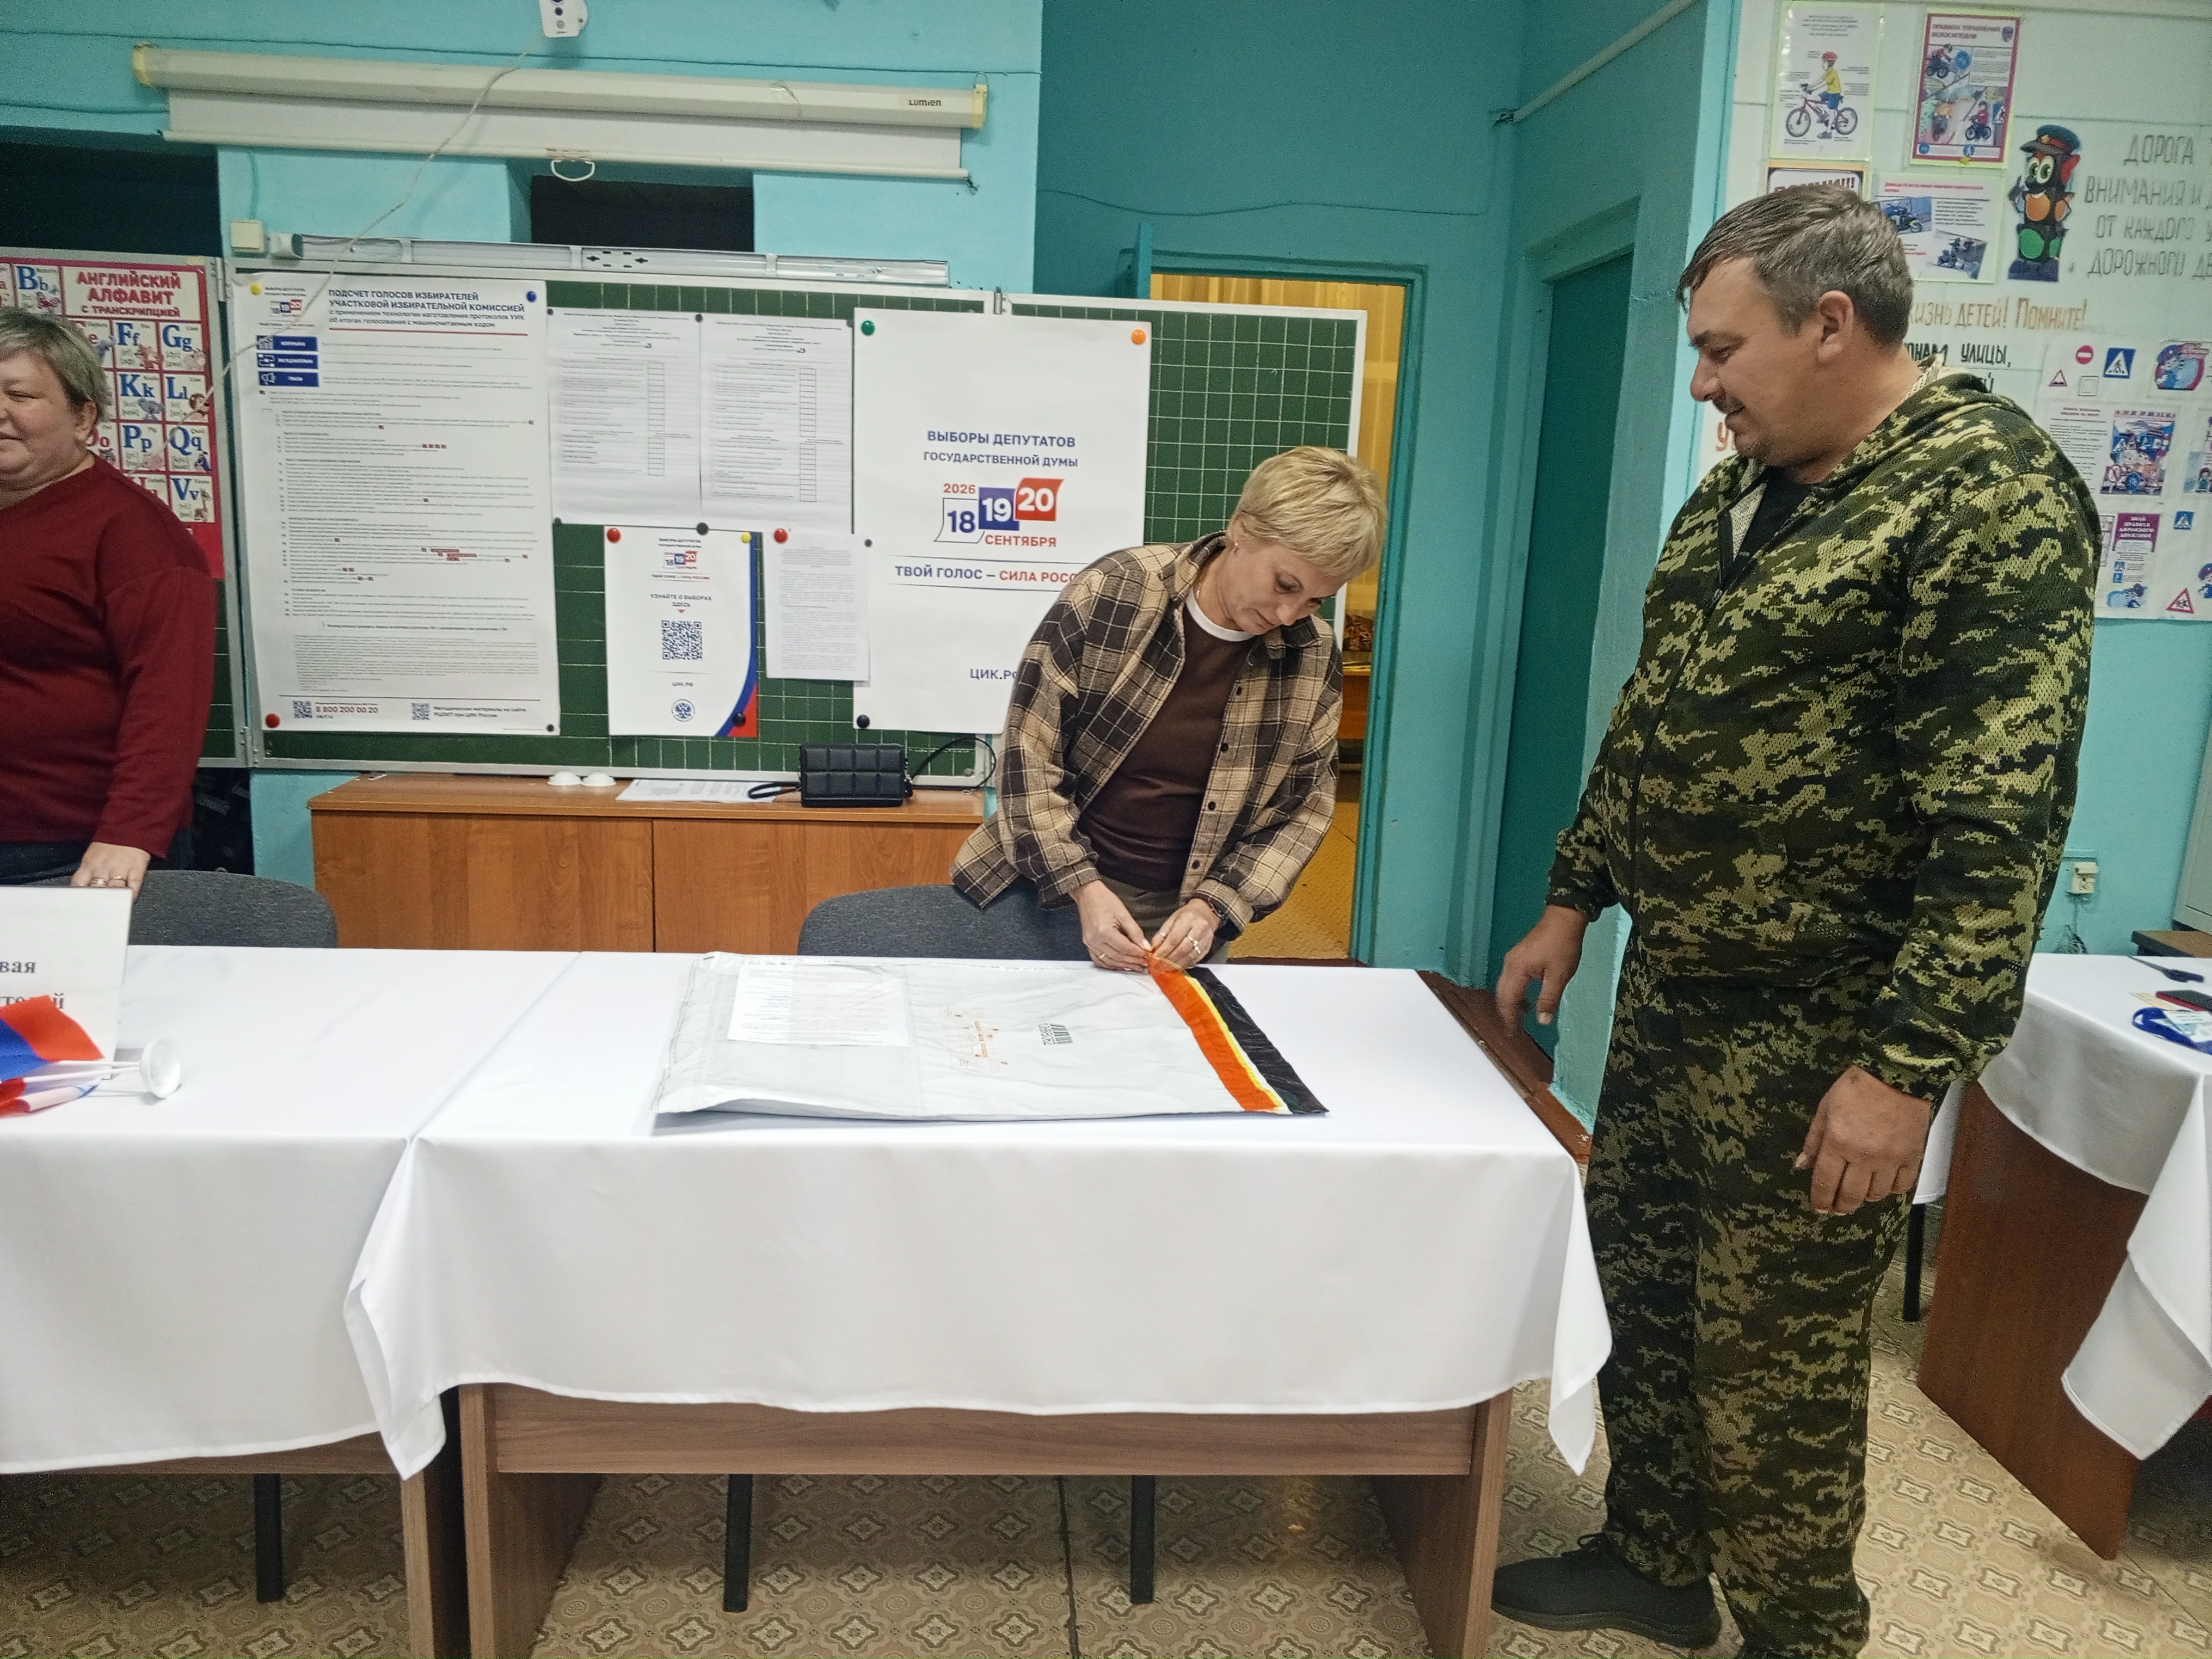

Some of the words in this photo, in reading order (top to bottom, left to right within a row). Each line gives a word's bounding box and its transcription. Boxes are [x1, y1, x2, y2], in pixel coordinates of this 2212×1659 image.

[2123, 133, 2194, 166] ДОРОГА
[2097, 214, 2118, 238] ОТ
[2123, 217, 2195, 243] КАЖДОГО
[2087, 248, 2186, 278] ДОРОЖНОГО
[77, 269, 181, 289] АНГЛИЙСКИЙ
[89, 287, 174, 305] АЛФАВИТ
[328, 289, 369, 298] ПОДСЧЕТ
[371, 290, 413, 299] ГОЛОСОВ
[415, 291, 479, 300] ИЗБИРАТЕЛЕЙ
[92, 306, 181, 317] ТРАНСКРИПЦИЕЙ
[329, 299, 389, 309] УЧАСТКОВОЙ
[391, 300, 467, 310] ИЗБИРАТЕЛЬНОЙ
[469, 304, 525, 312] КОМИССИЕЙ
[927, 431, 989, 444] ВЫБОРЫ
[993, 434, 1076, 447] ДЕПУТАТОВ
[924, 451, 1040, 465] ГОСУДАРСТВЕННОЙ
[1042, 458, 1078, 468] ДУМЫ
[943, 483, 976, 494] 2026
[947, 510, 976, 533] 18
[981, 497, 1012, 522] 19
[1017, 487, 1055, 512] 20
[985, 535, 1056, 547] СЕНТЯБРЯ
[895, 564, 932, 577] ТВОЙ
[937, 568, 983, 580] ГОЛОС
[1000, 570, 1037, 582] СИЛА
